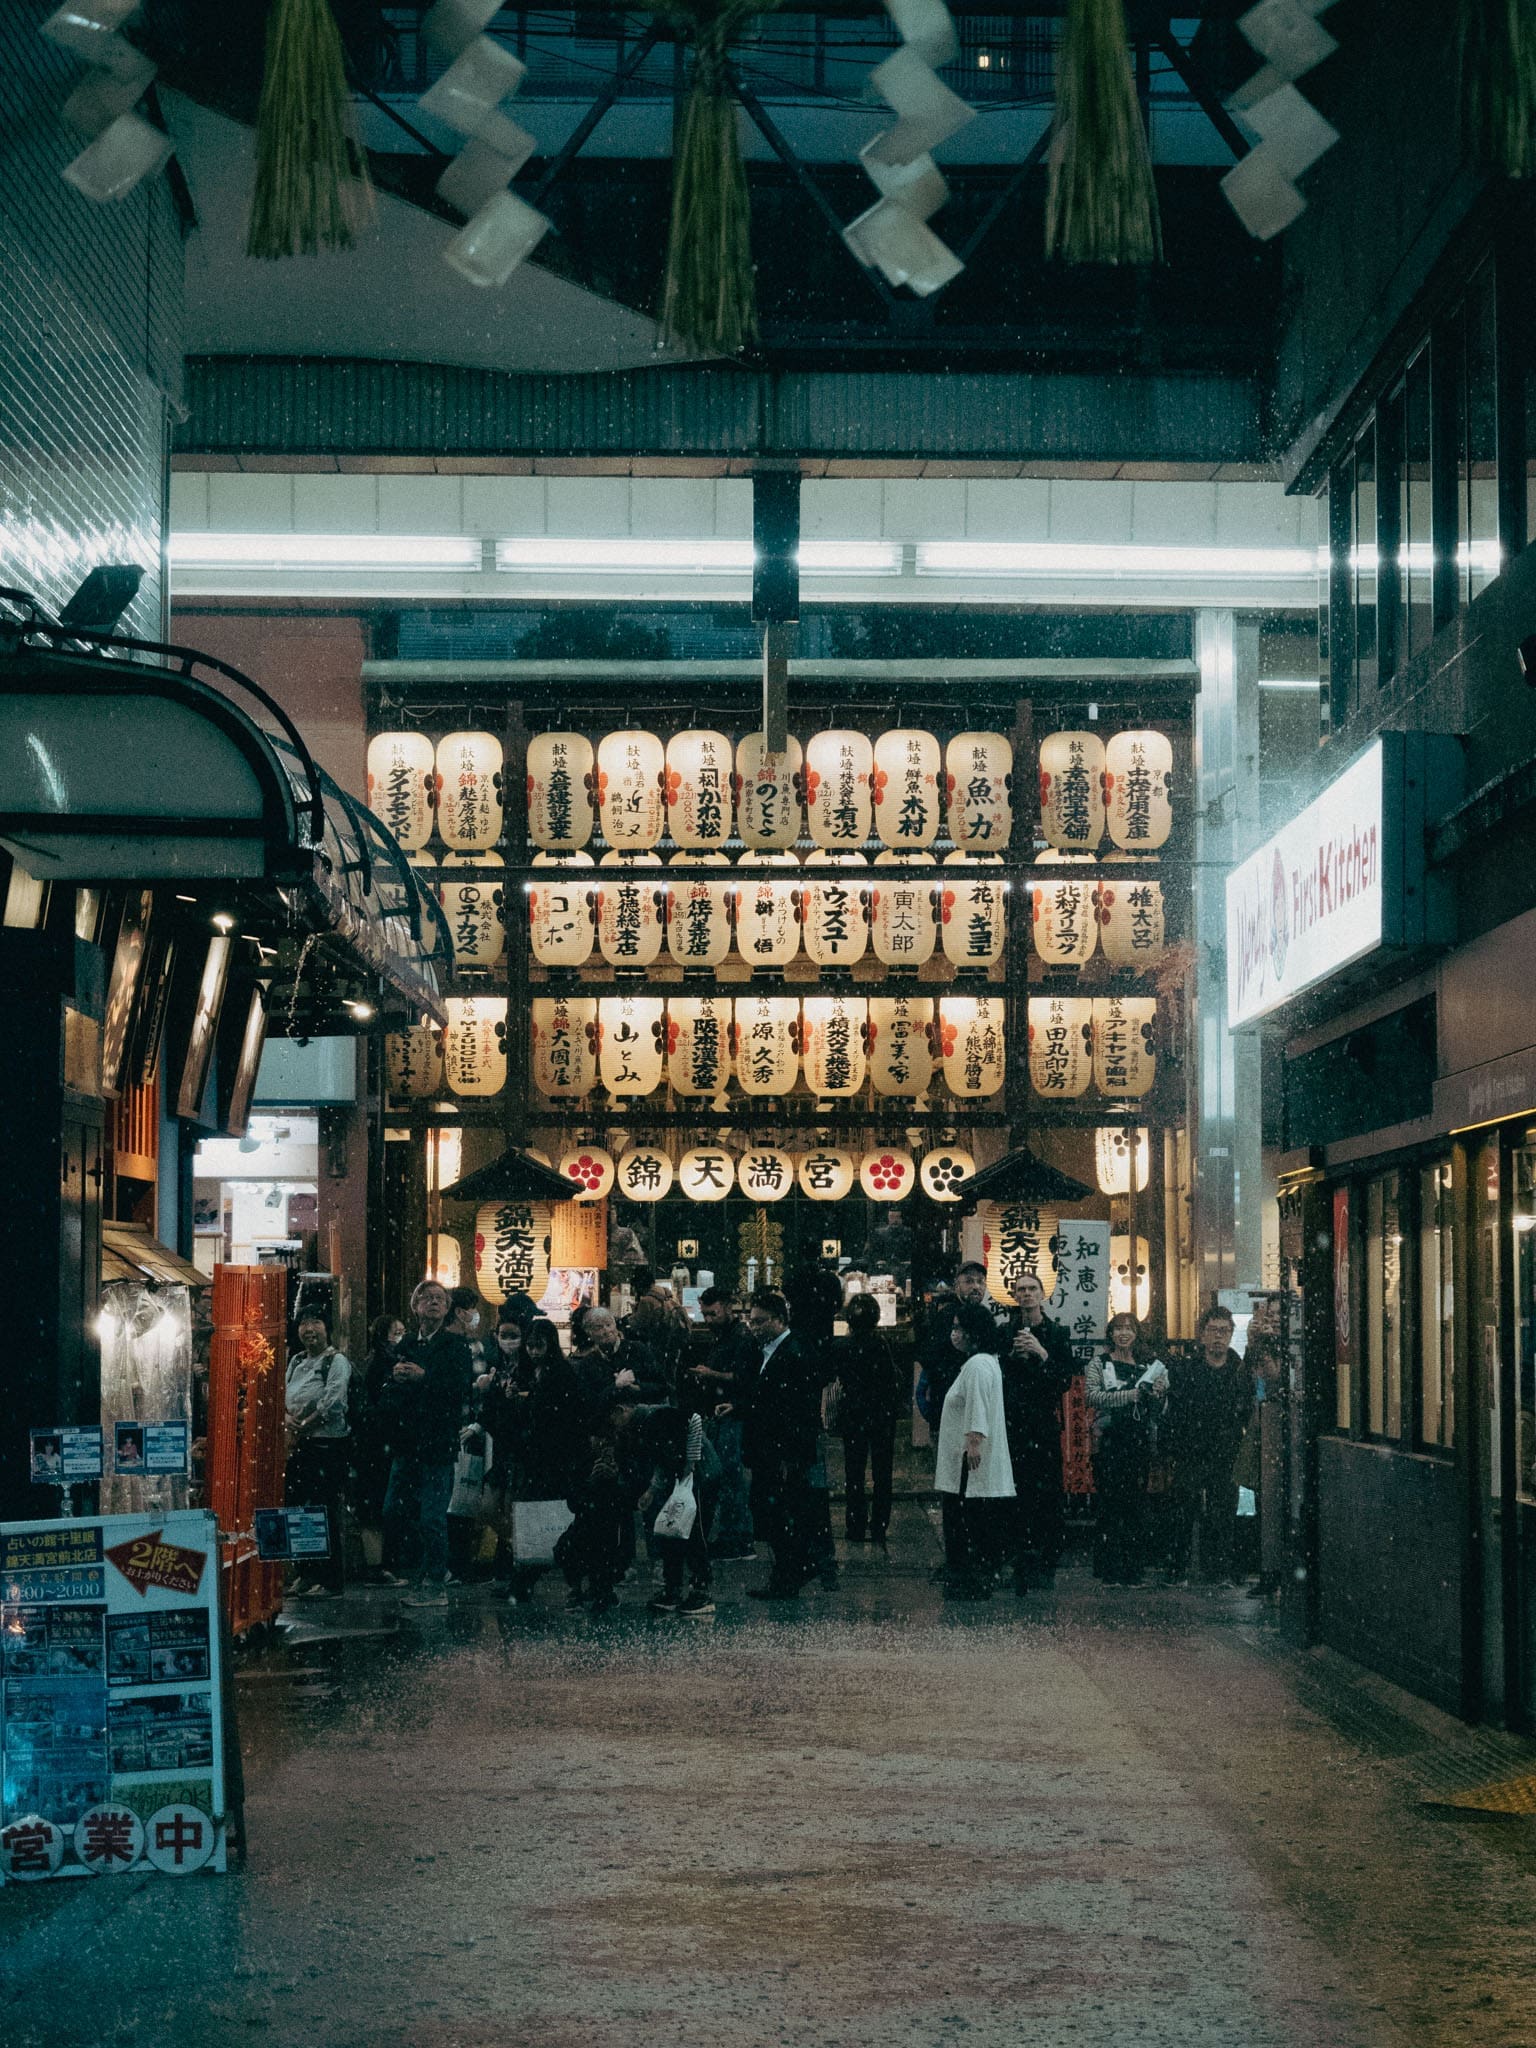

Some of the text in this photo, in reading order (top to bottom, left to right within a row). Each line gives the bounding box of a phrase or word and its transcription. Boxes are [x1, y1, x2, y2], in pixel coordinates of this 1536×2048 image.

[965, 776, 995, 840] 魚力
[891, 890, 916, 953] 寅太郎
[1055, 885, 1080, 955] 北村クリニック
[613, 1021, 642, 1083] 山とみ
[1045, 1028, 1069, 1090] 田丸印房
[494, 1205, 535, 1297] 錦天満宮
[128, 1542, 198, 1580] 2階へ
